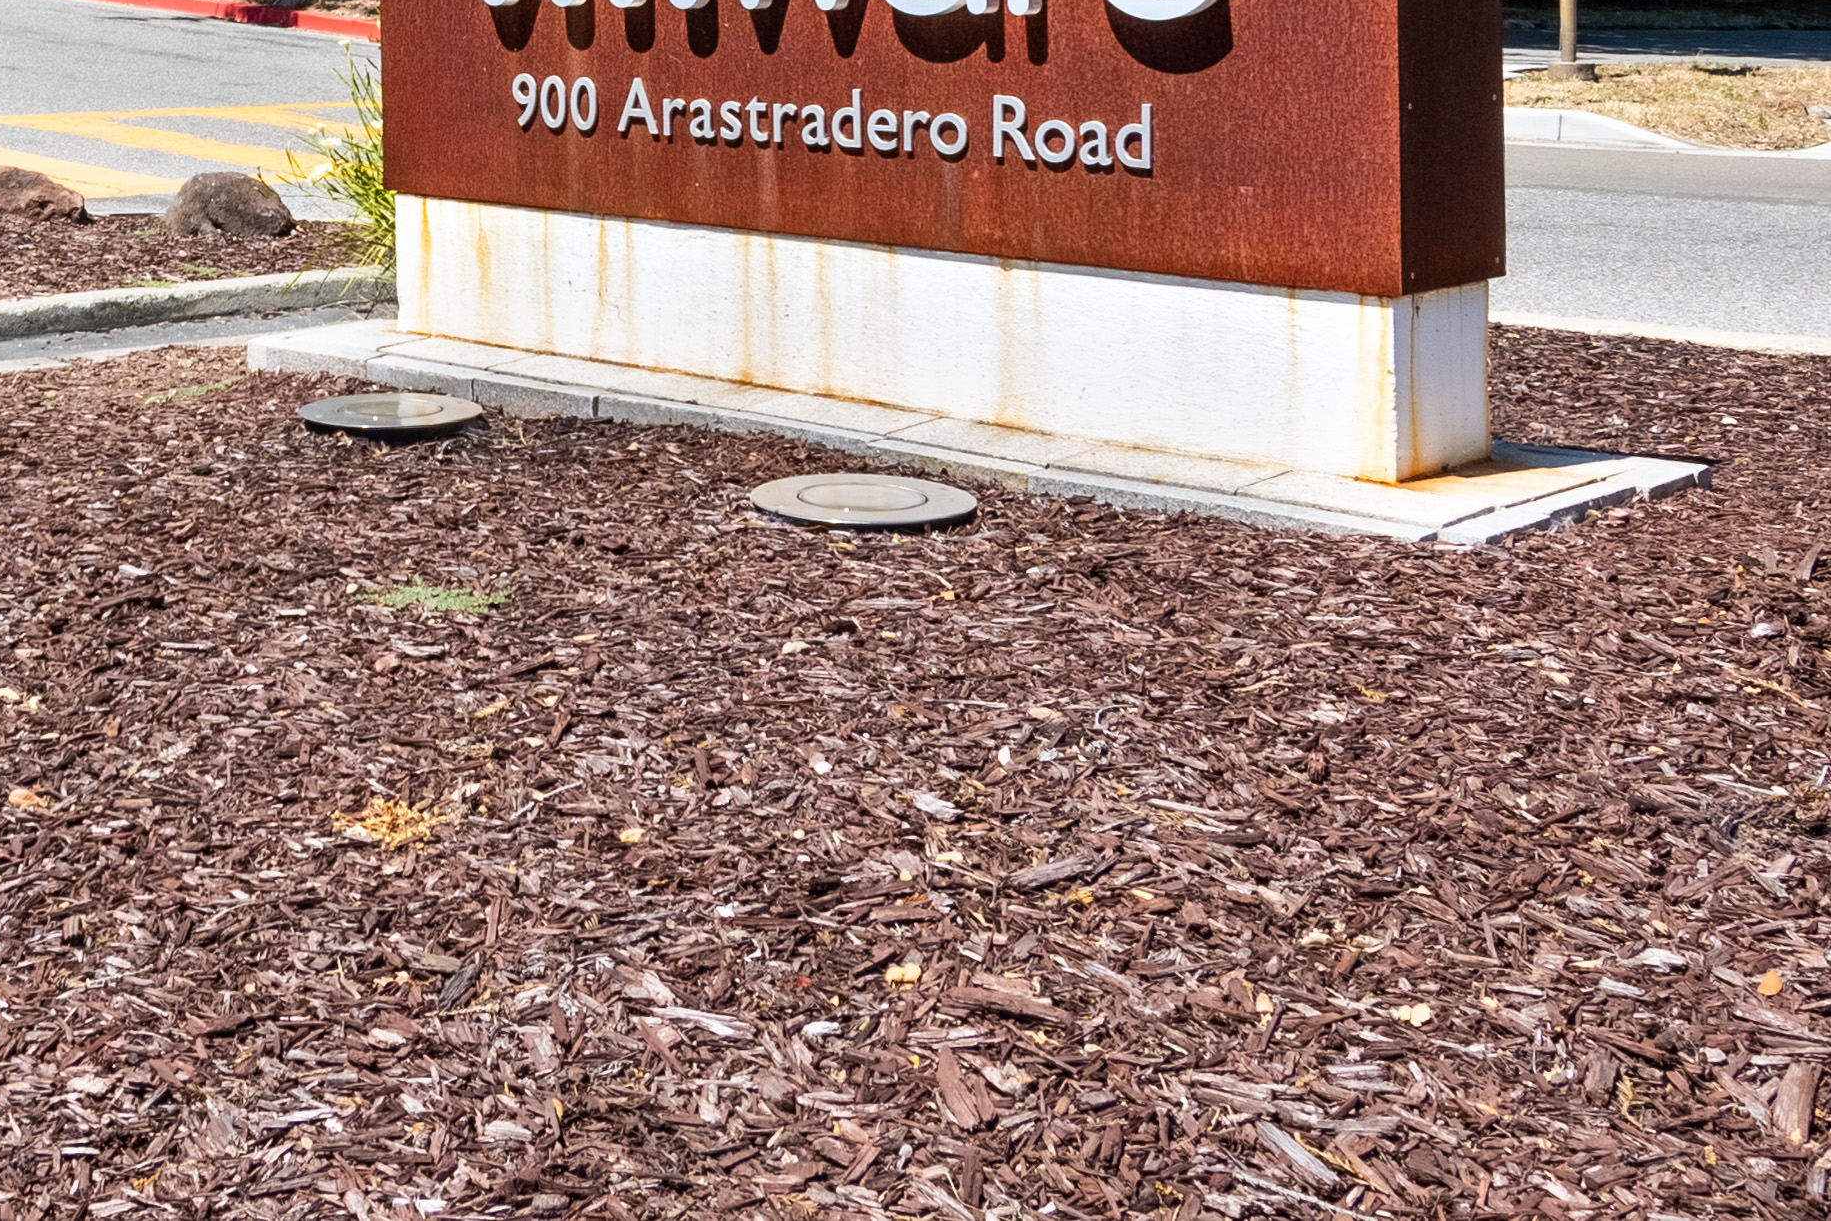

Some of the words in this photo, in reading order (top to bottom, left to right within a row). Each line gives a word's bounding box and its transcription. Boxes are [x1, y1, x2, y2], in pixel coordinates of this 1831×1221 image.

[512, 72, 600, 131] 900
[618, 76, 969, 157] Arastradero
[993, 93, 1154, 171] Road
